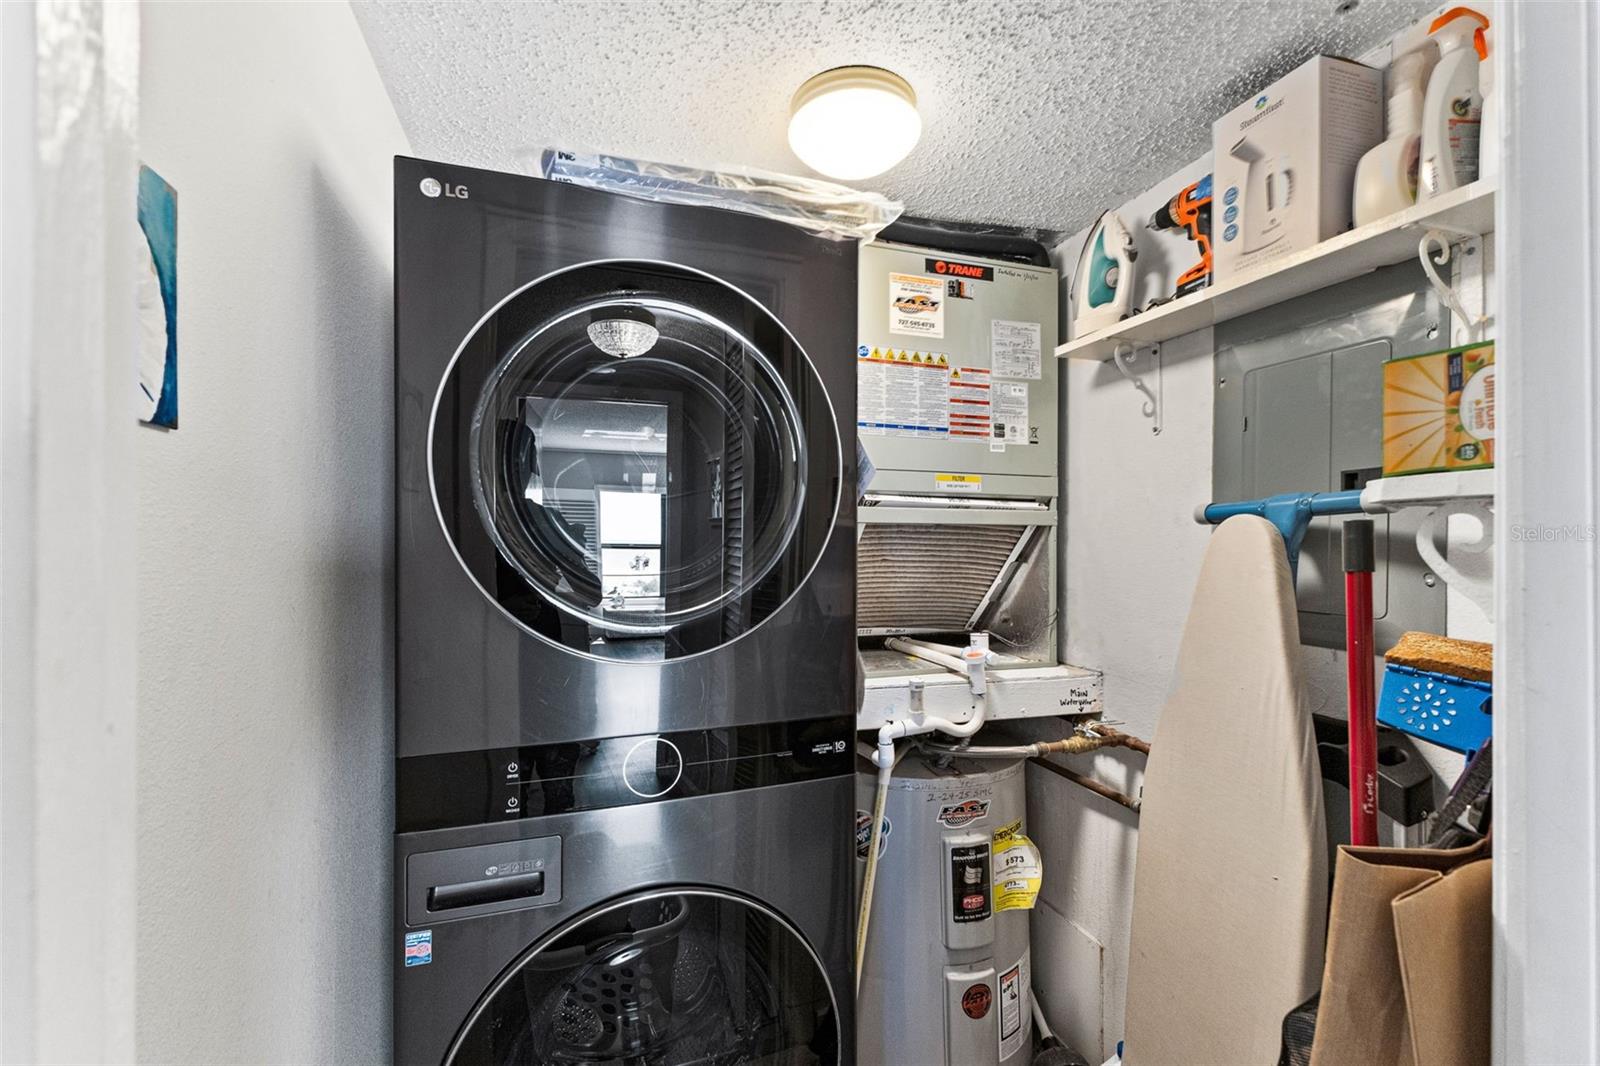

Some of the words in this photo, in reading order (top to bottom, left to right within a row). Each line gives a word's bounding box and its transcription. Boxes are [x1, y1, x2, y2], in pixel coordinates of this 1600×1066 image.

[445, 183, 468, 199] LG
[948, 264, 984, 277] TRANE
[896, 297, 939, 306] FAST
[942, 801, 988, 814] FAST
[1006, 855, 1025, 866] $573
